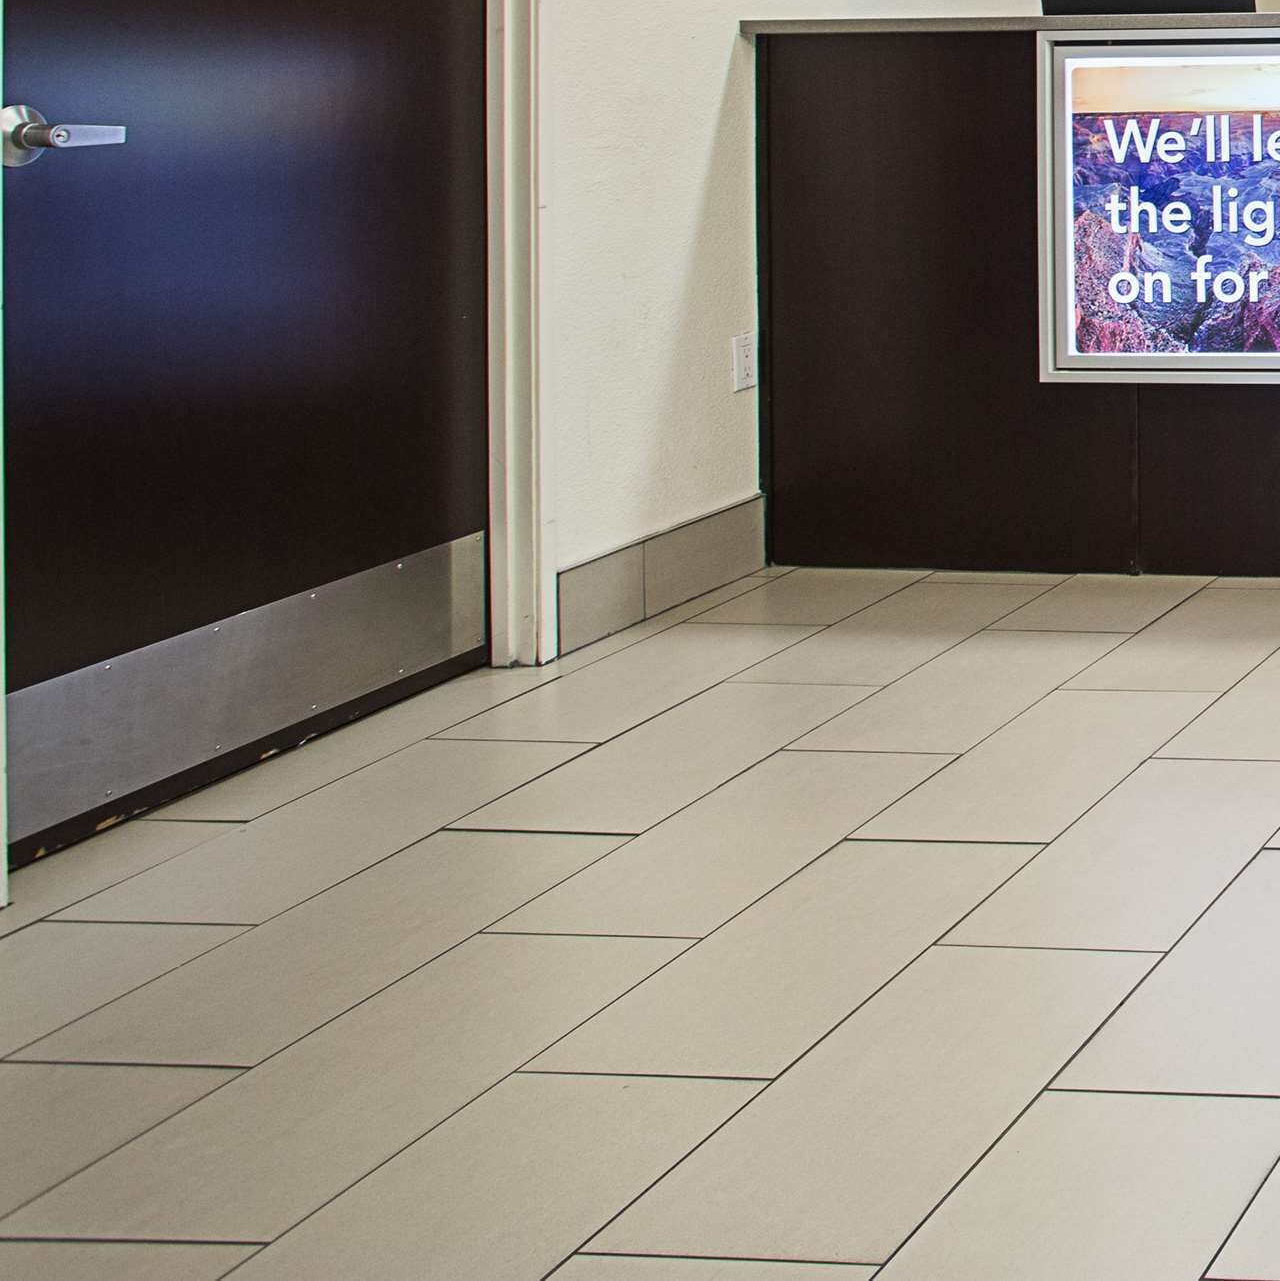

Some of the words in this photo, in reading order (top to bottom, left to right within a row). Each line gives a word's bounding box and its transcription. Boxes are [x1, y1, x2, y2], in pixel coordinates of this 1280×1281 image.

[1104, 113, 1230, 164] We'll
[1105, 188, 1191, 234] the
[1107, 267, 1171, 304] on
[1191, 255, 1273, 304] for
